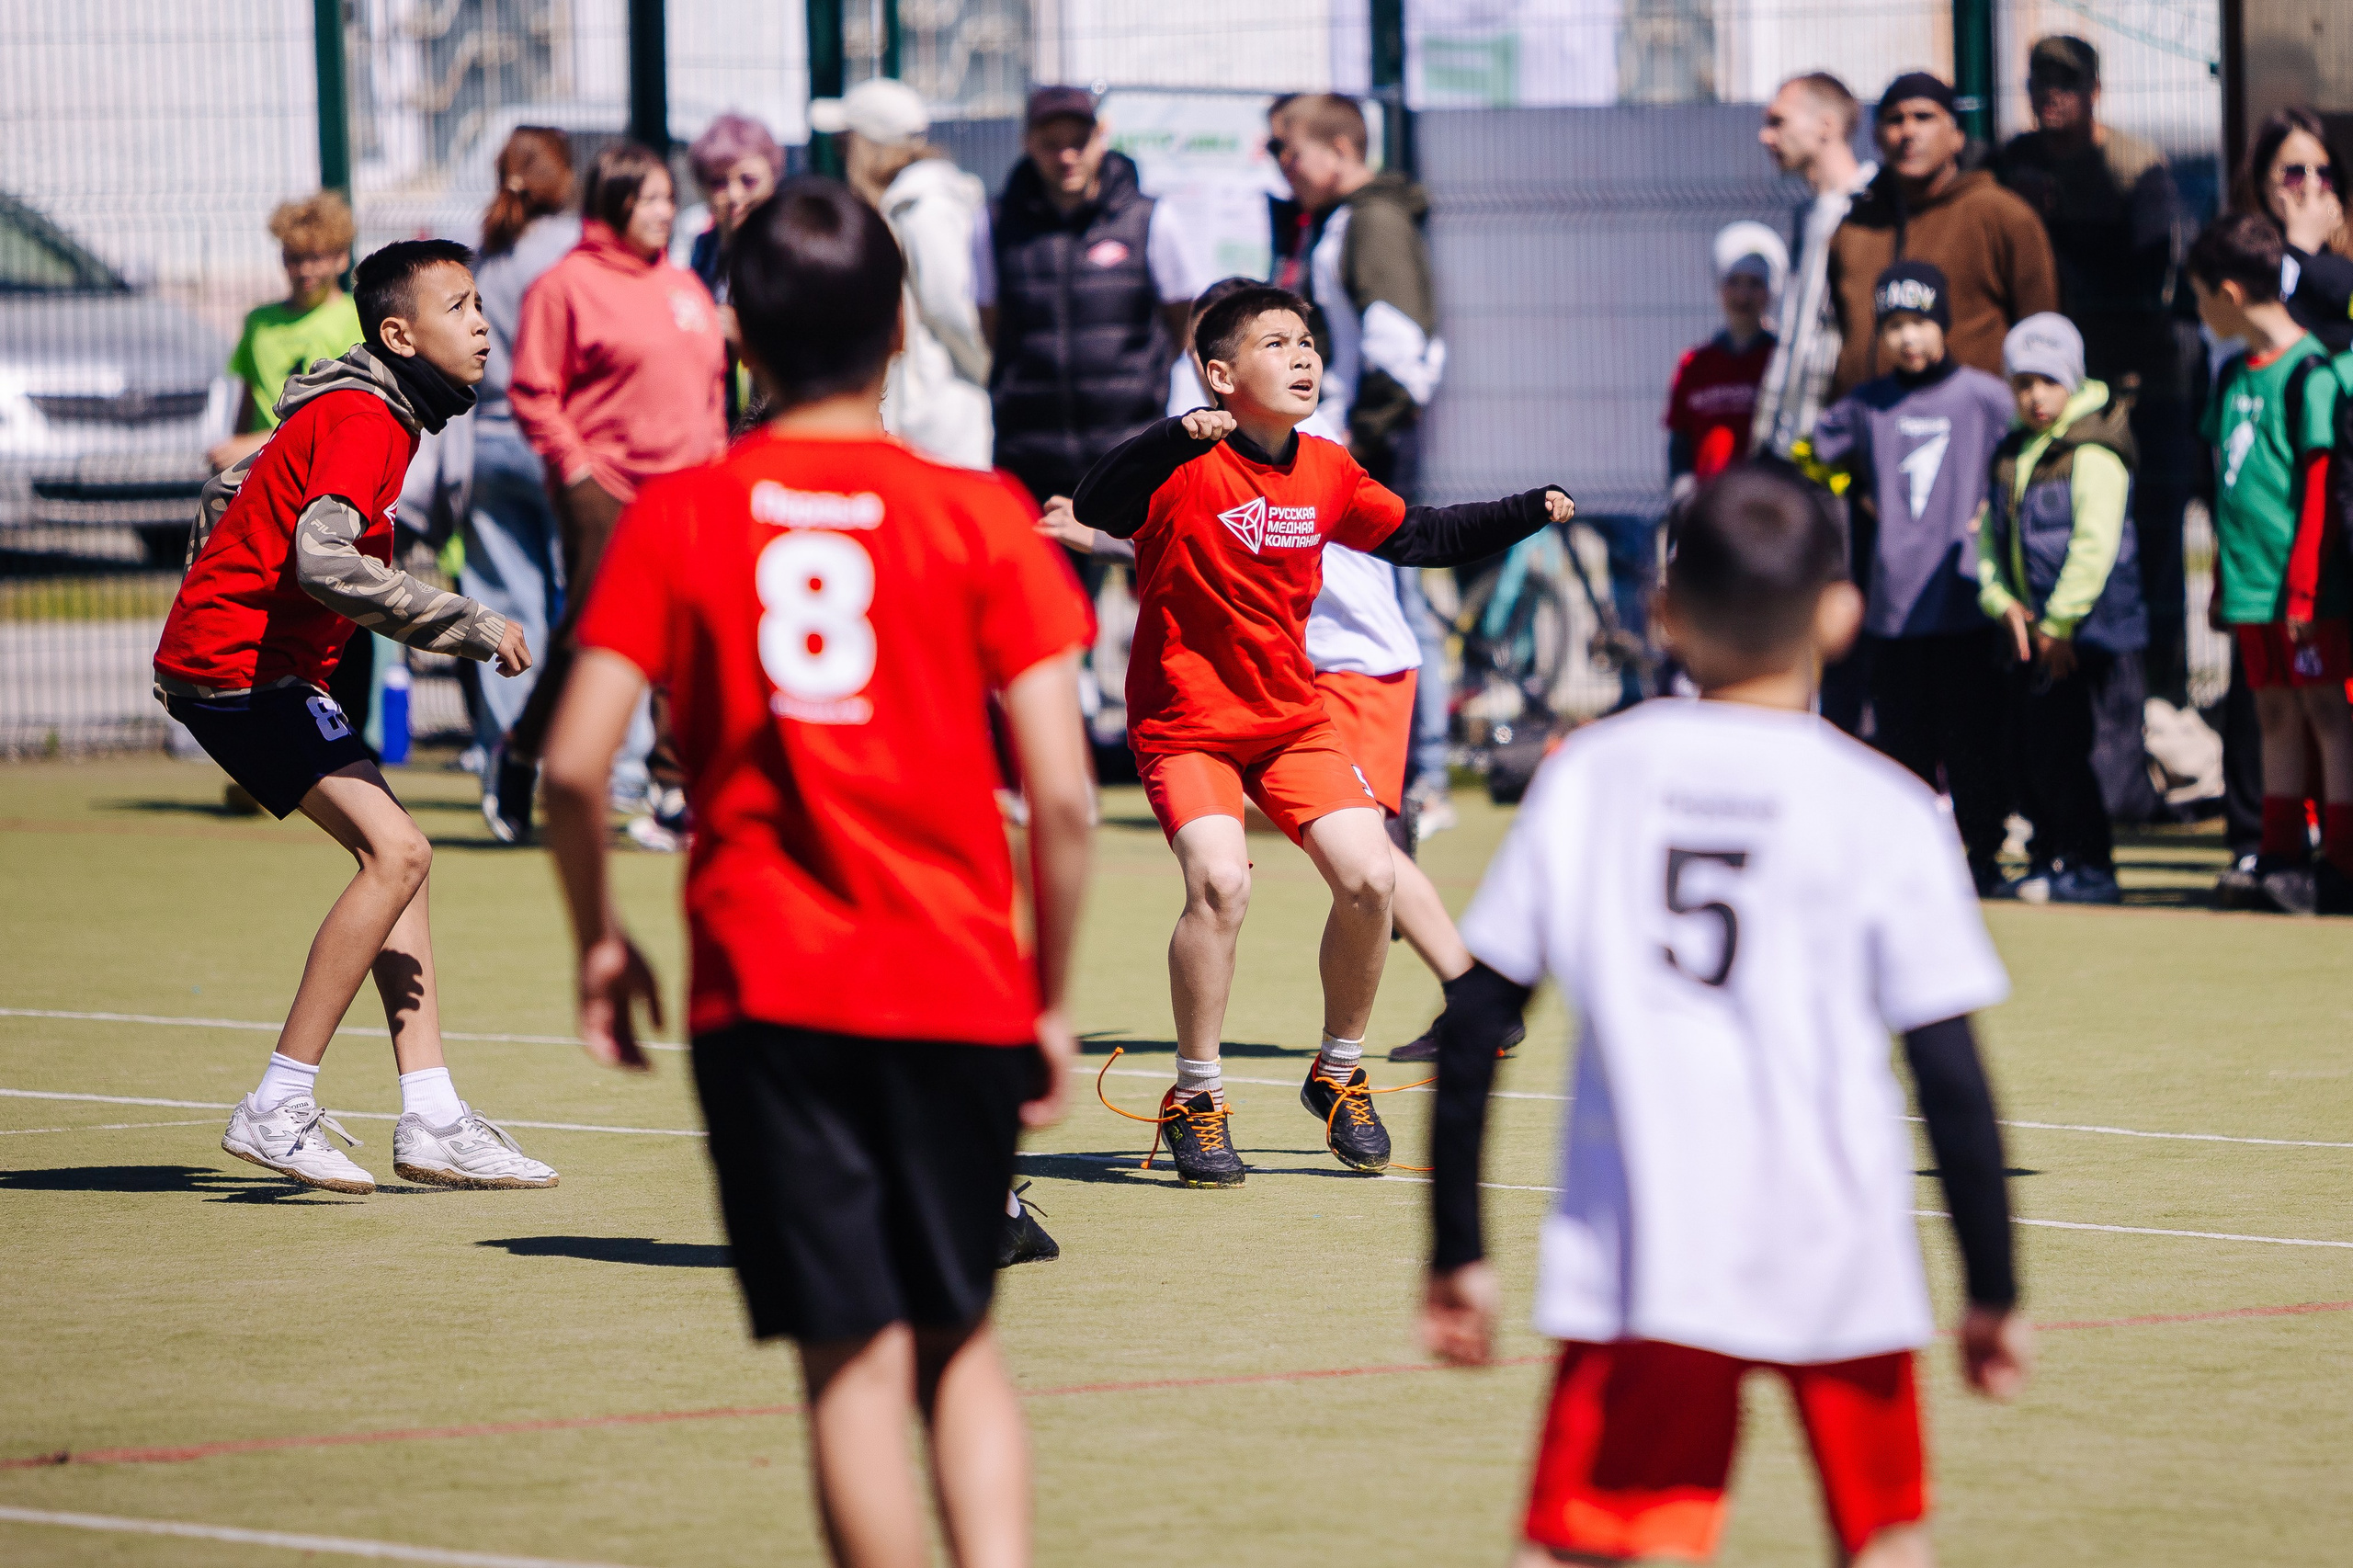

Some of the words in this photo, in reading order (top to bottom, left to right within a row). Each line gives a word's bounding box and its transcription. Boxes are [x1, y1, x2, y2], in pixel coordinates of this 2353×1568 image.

[1268, 506, 1315, 520] РУССКАЯ
[1267, 520, 1314, 534] МЕДНАЯ
[755, 528, 878, 704] 8
[1660, 846, 1750, 988] 5
[290, 1101, 310, 1109] oma
